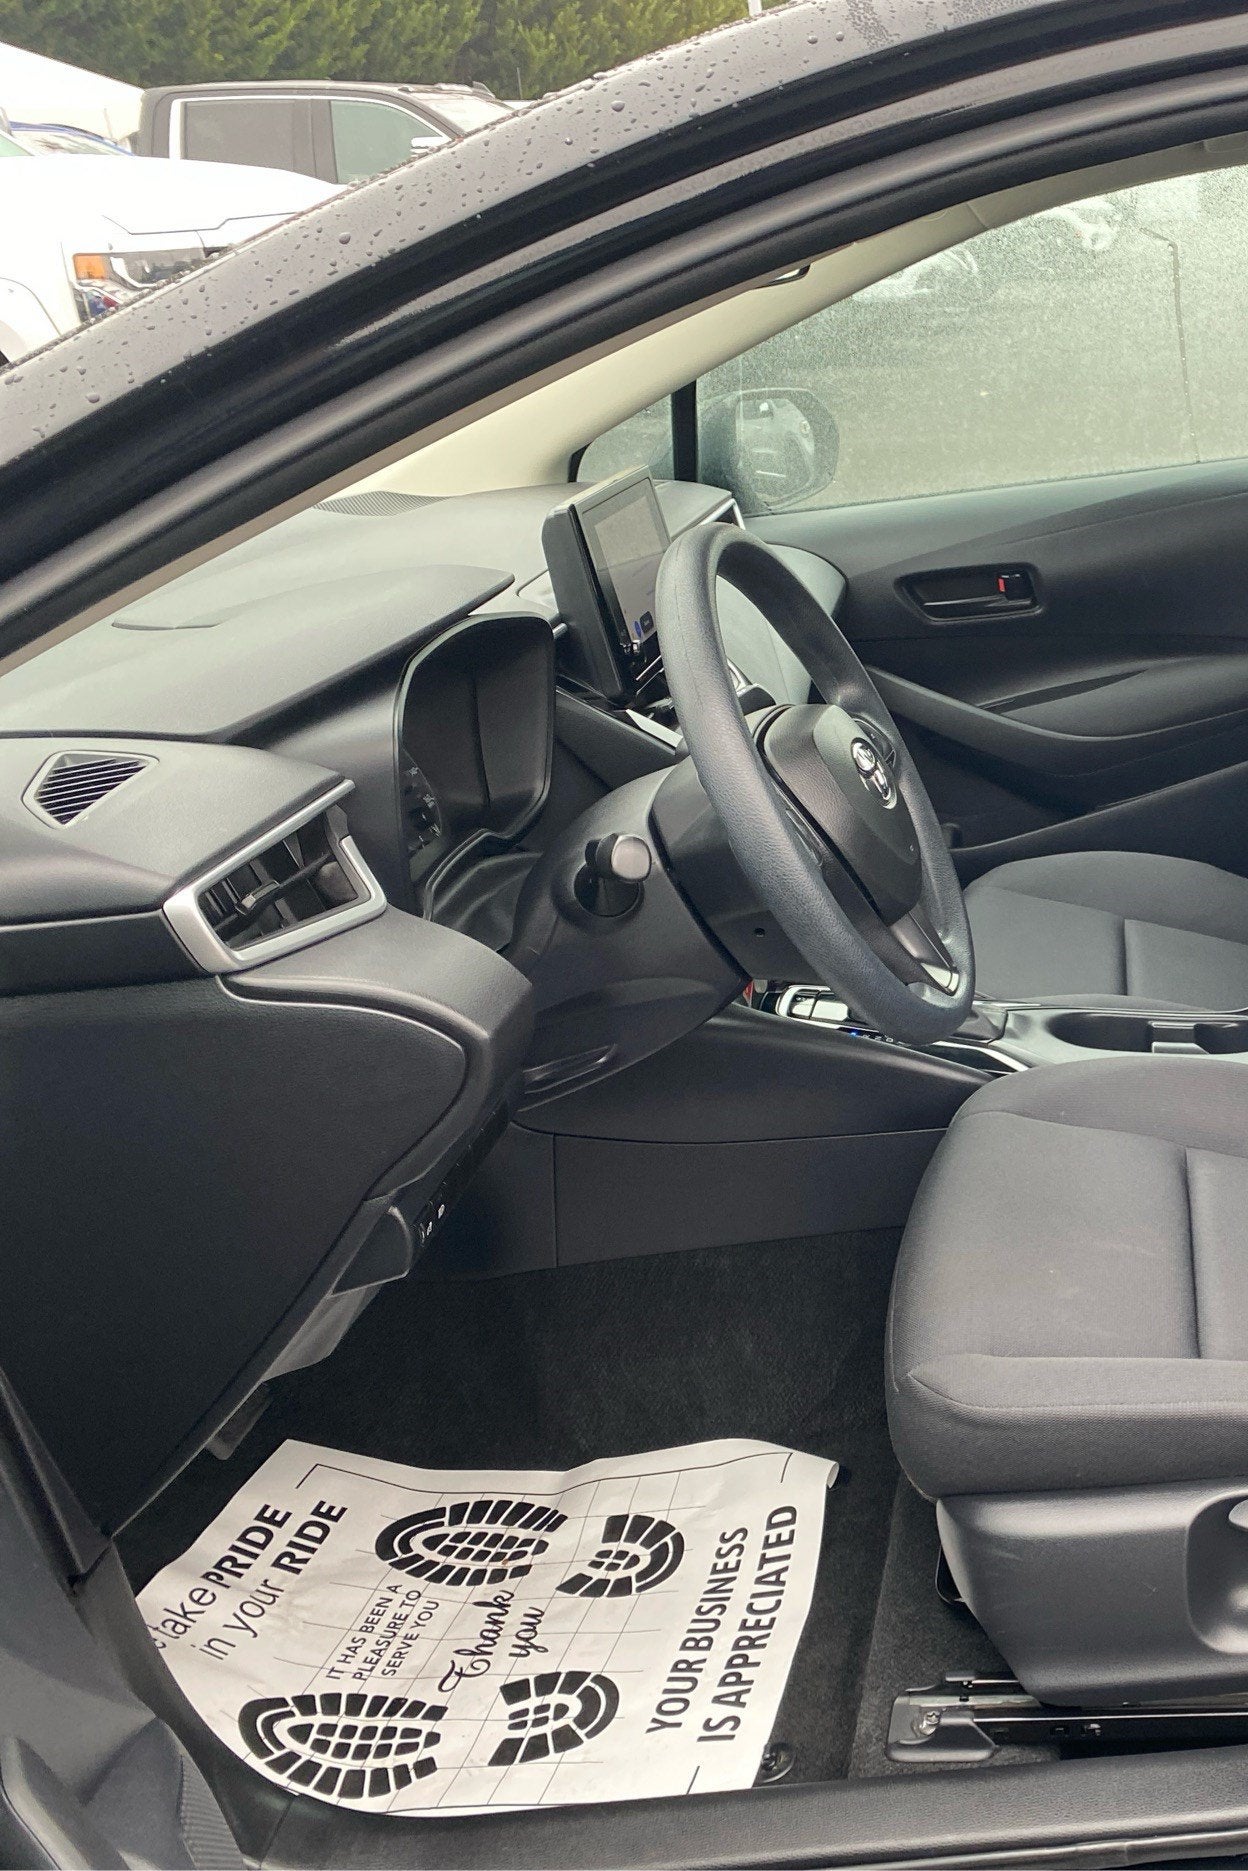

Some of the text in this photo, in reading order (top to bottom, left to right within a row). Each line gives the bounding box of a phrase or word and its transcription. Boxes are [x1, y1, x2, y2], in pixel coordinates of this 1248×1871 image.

[147, 1503, 293, 1640] take PRIDE
[190, 1500, 348, 1661] in your RIDE
[696, 1504, 798, 1743] IS APPRECIATED
[325, 1583, 403, 1680] IT HAS BEEN A
[352, 1589, 421, 1681] PLEASURE TO
[382, 1600, 440, 1677] SERVE YOU
[437, 1589, 515, 1693] Thank
[508, 1606, 549, 1658] you
[645, 1526, 749, 1735] YOUR BUSINESS
